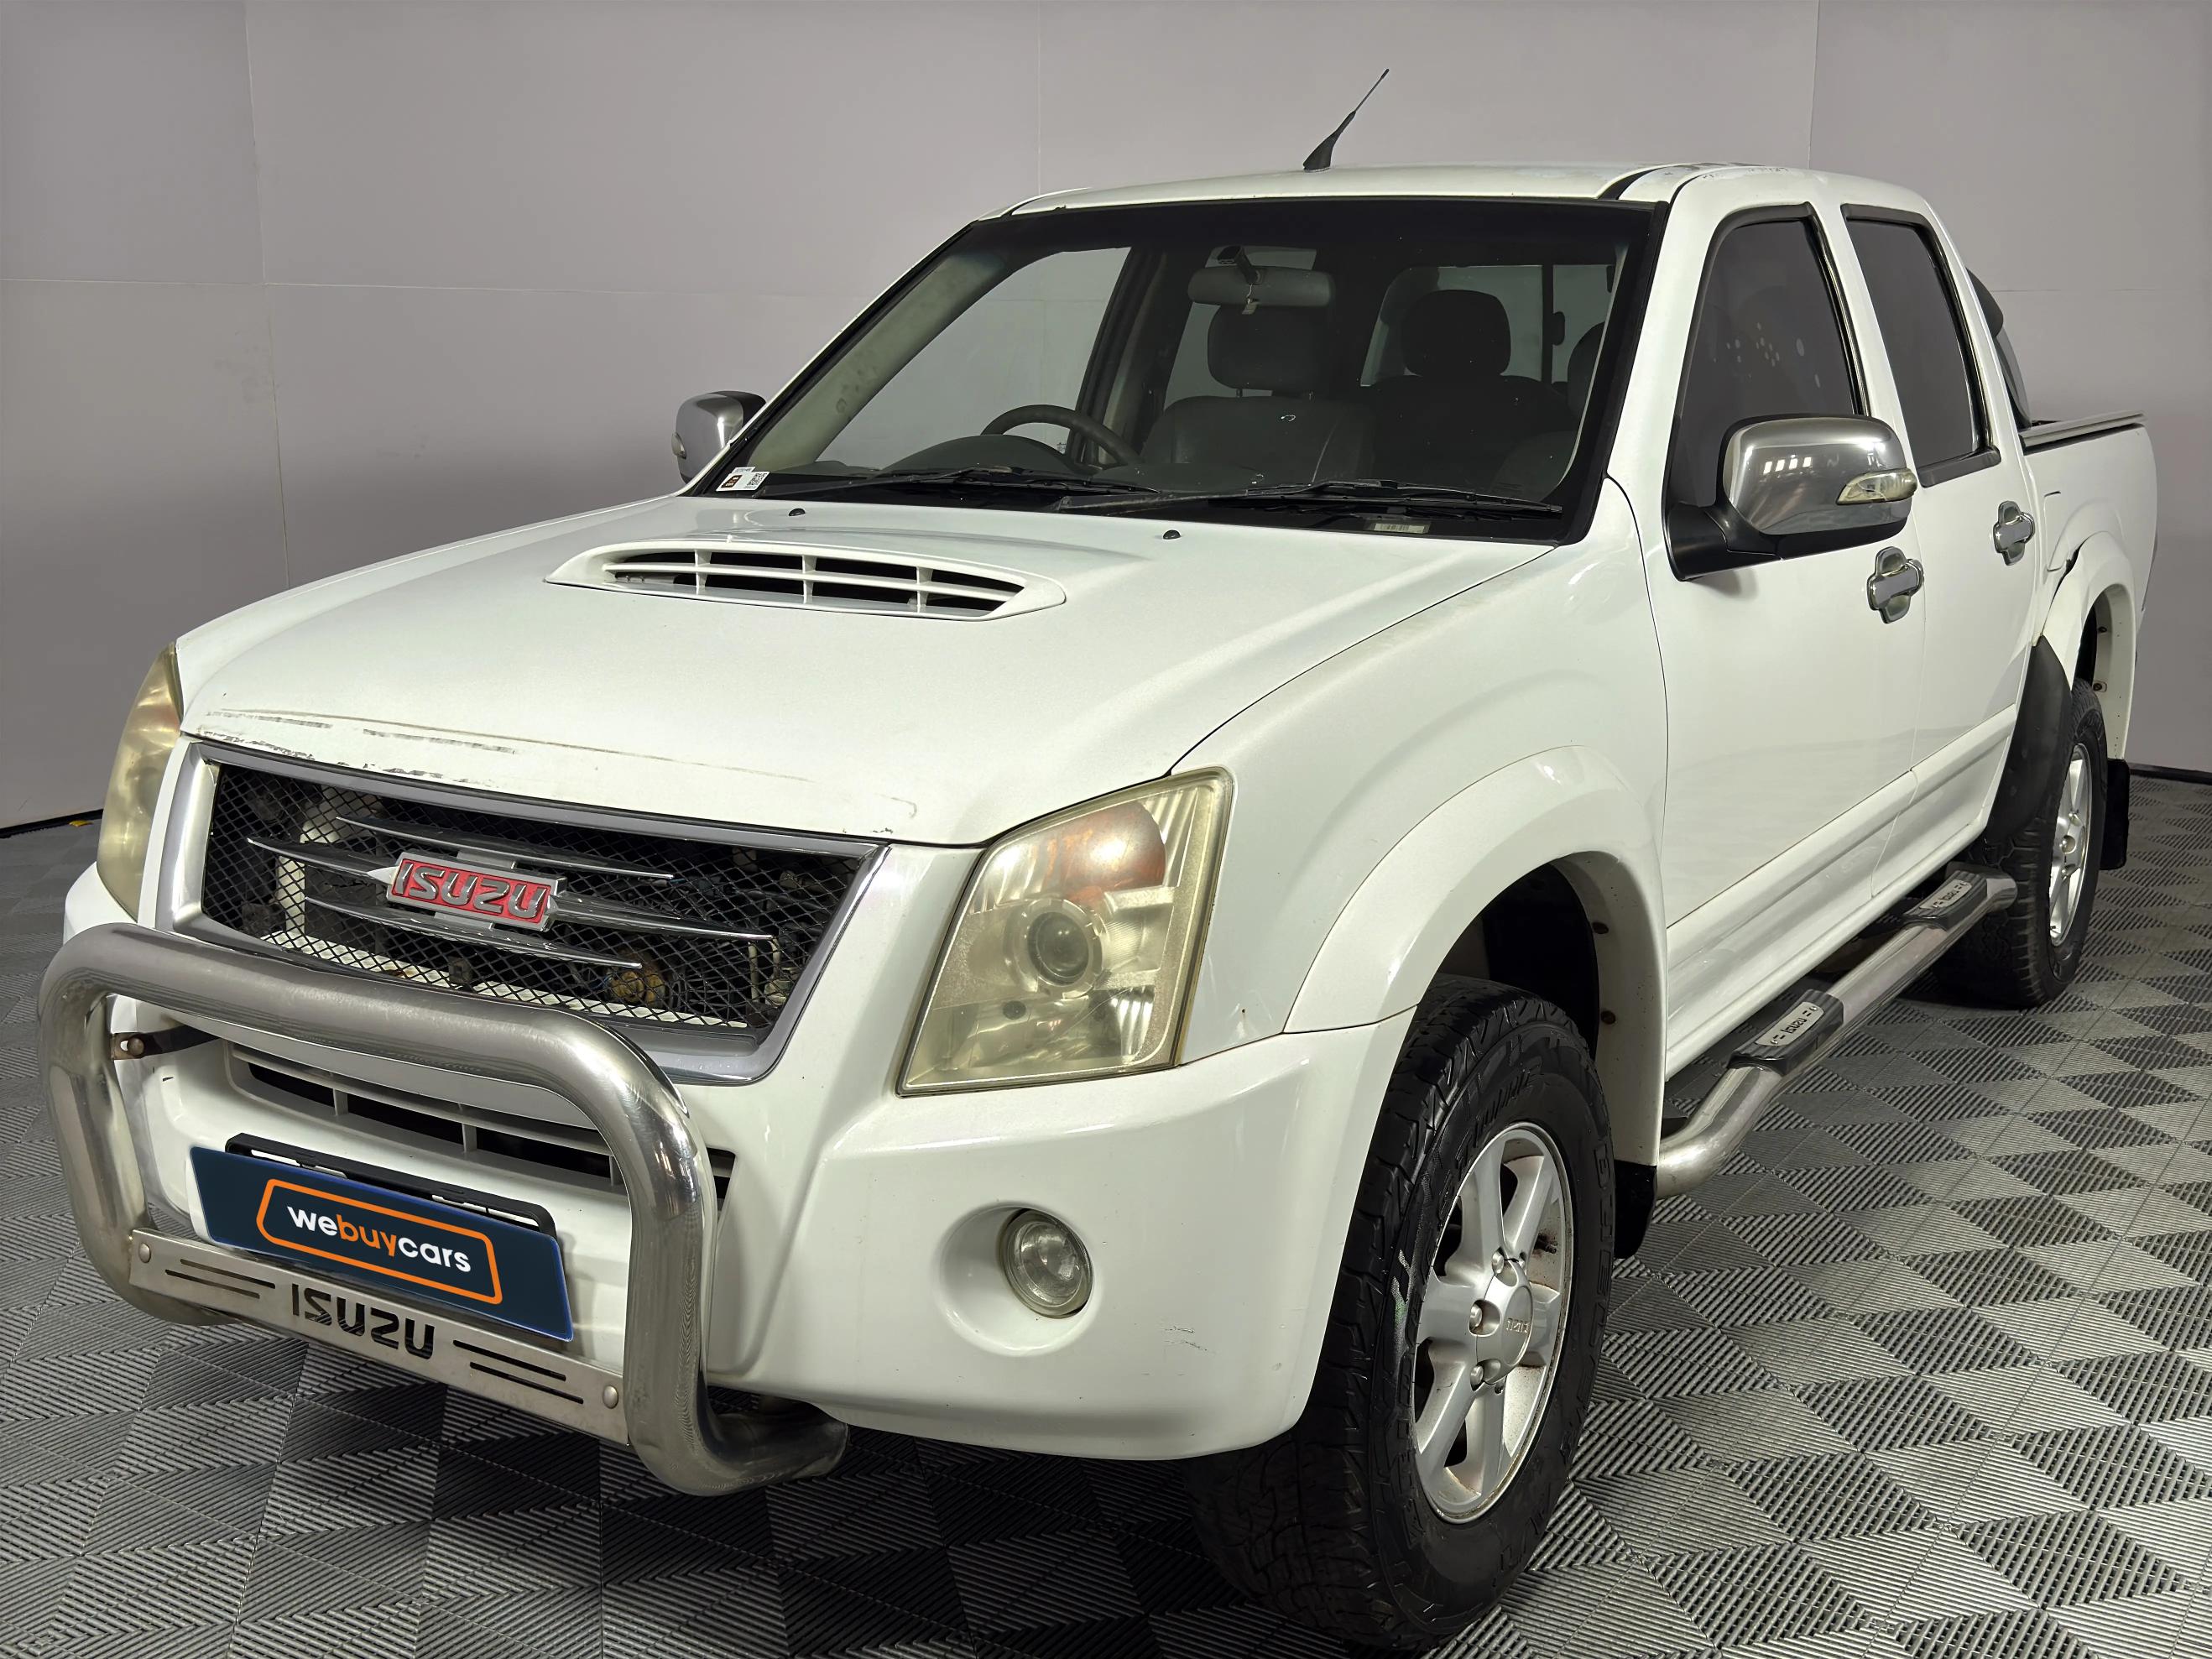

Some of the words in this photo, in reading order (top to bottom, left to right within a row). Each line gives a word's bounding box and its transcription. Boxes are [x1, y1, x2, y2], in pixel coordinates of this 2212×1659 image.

[395, 862, 548, 920] ISUZU
[1780, 1017, 1808, 1034] ISUZU
[287, 1205, 472, 1274] webuycars
[291, 1283, 436, 1360] ISUZU
